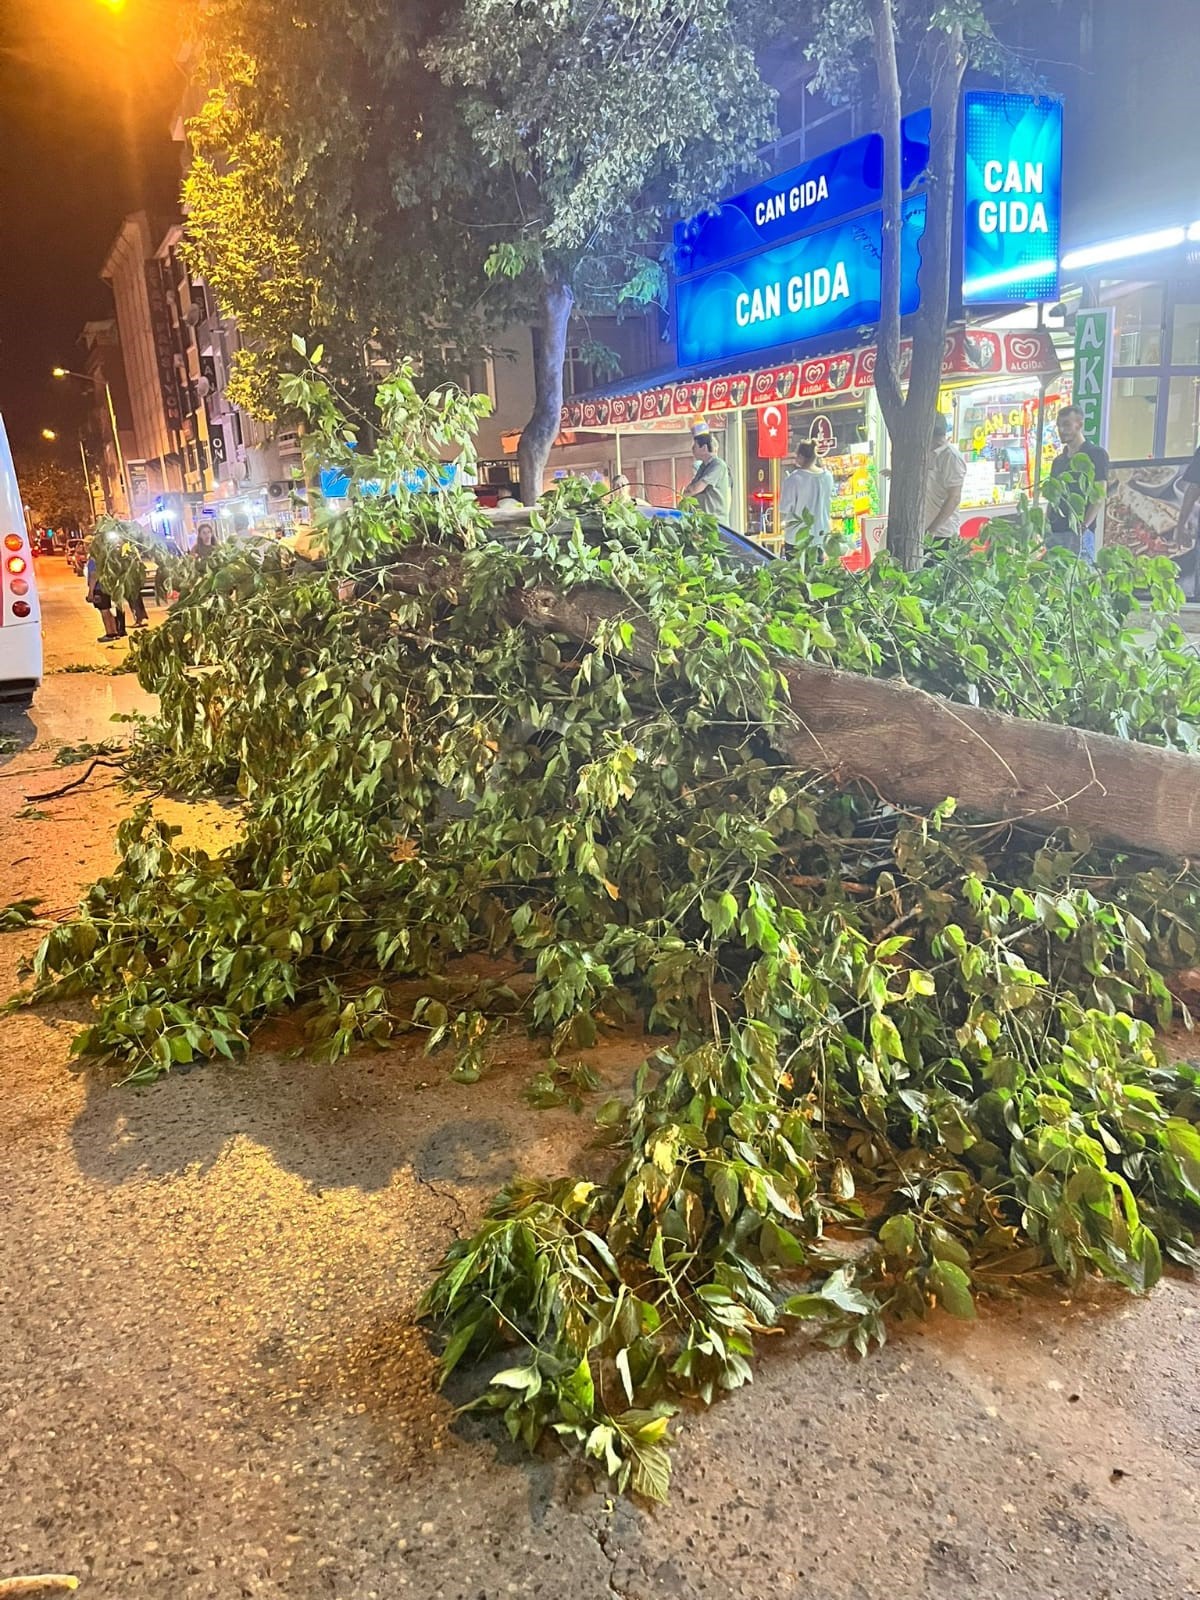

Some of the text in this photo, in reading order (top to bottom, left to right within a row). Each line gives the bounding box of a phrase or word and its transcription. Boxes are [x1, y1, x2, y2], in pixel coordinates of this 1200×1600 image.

[984, 160, 1043, 194] CAN
[755, 175, 829, 226] CAN GIDA
[978, 200, 1049, 234] GIDA
[735, 260, 850, 327] CAN GIDA
[1078, 317, 1104, 445] AKE
[973, 411, 1004, 440] CAN
